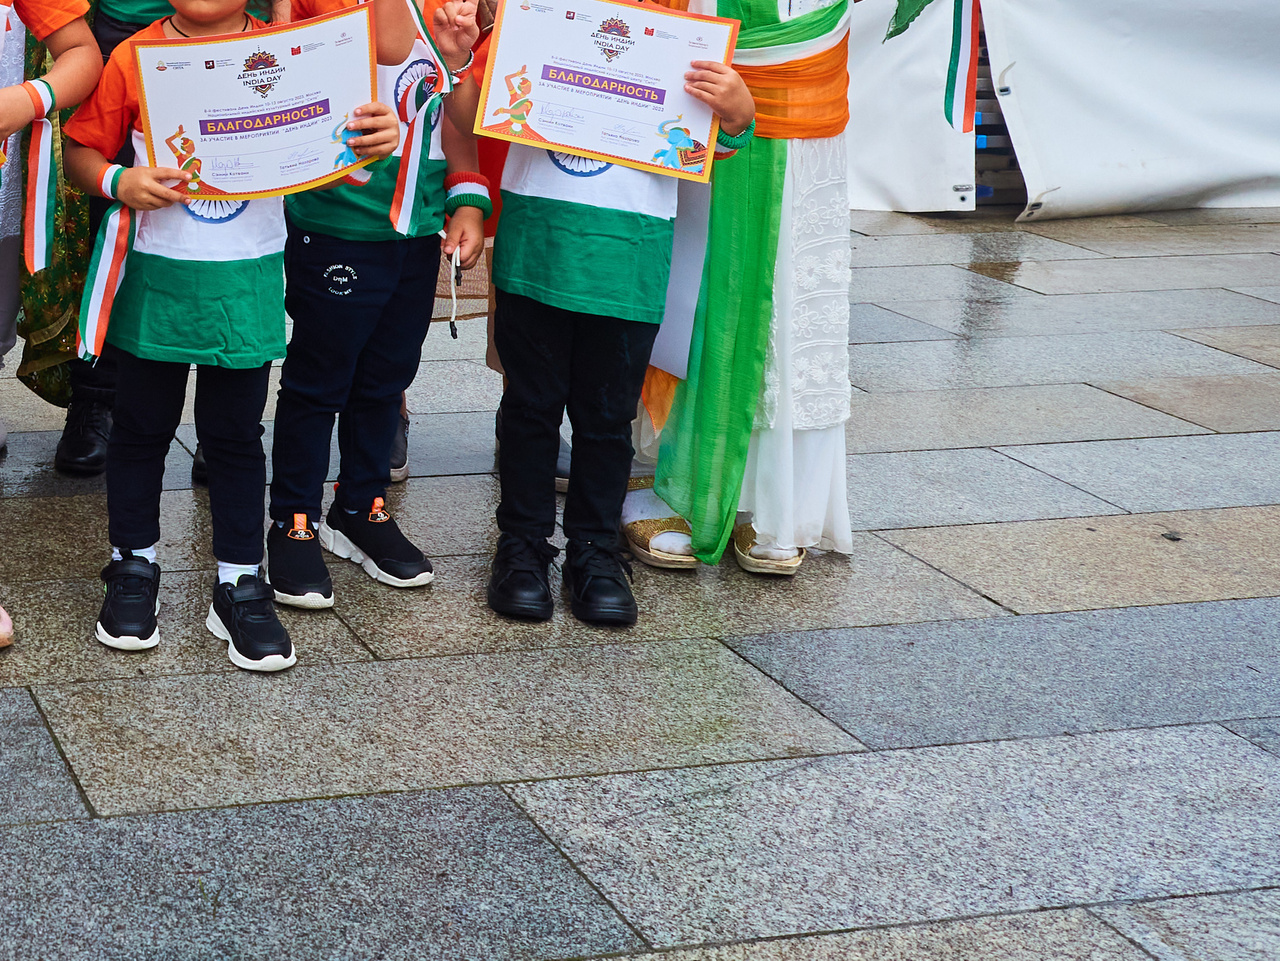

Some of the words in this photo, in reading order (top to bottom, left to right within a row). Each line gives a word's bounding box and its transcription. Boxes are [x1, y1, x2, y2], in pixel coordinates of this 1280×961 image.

[591, 32, 609, 40] ДЕНЬ
[610, 35, 635, 46] ИНДИИ
[593, 40, 614, 49] INDIA
[615, 43, 630, 52] DAY
[237, 71, 258, 80] ДЕНЬ
[259, 66, 286, 76] ИНДИИ
[243, 78, 265, 86] INDIA
[267, 75, 282, 83] DAY
[549, 70, 658, 100] БЛАГОДАРНОСТЬ
[546, 83, 569, 91] УЧАСТИЕ
[575, 89, 612, 100] МЕРОПРИЯТИИ
[207, 104, 324, 131] БЛАГОДАРНОСТЬ
[240, 130, 279, 139] МЕРОПРИЯТИИ
